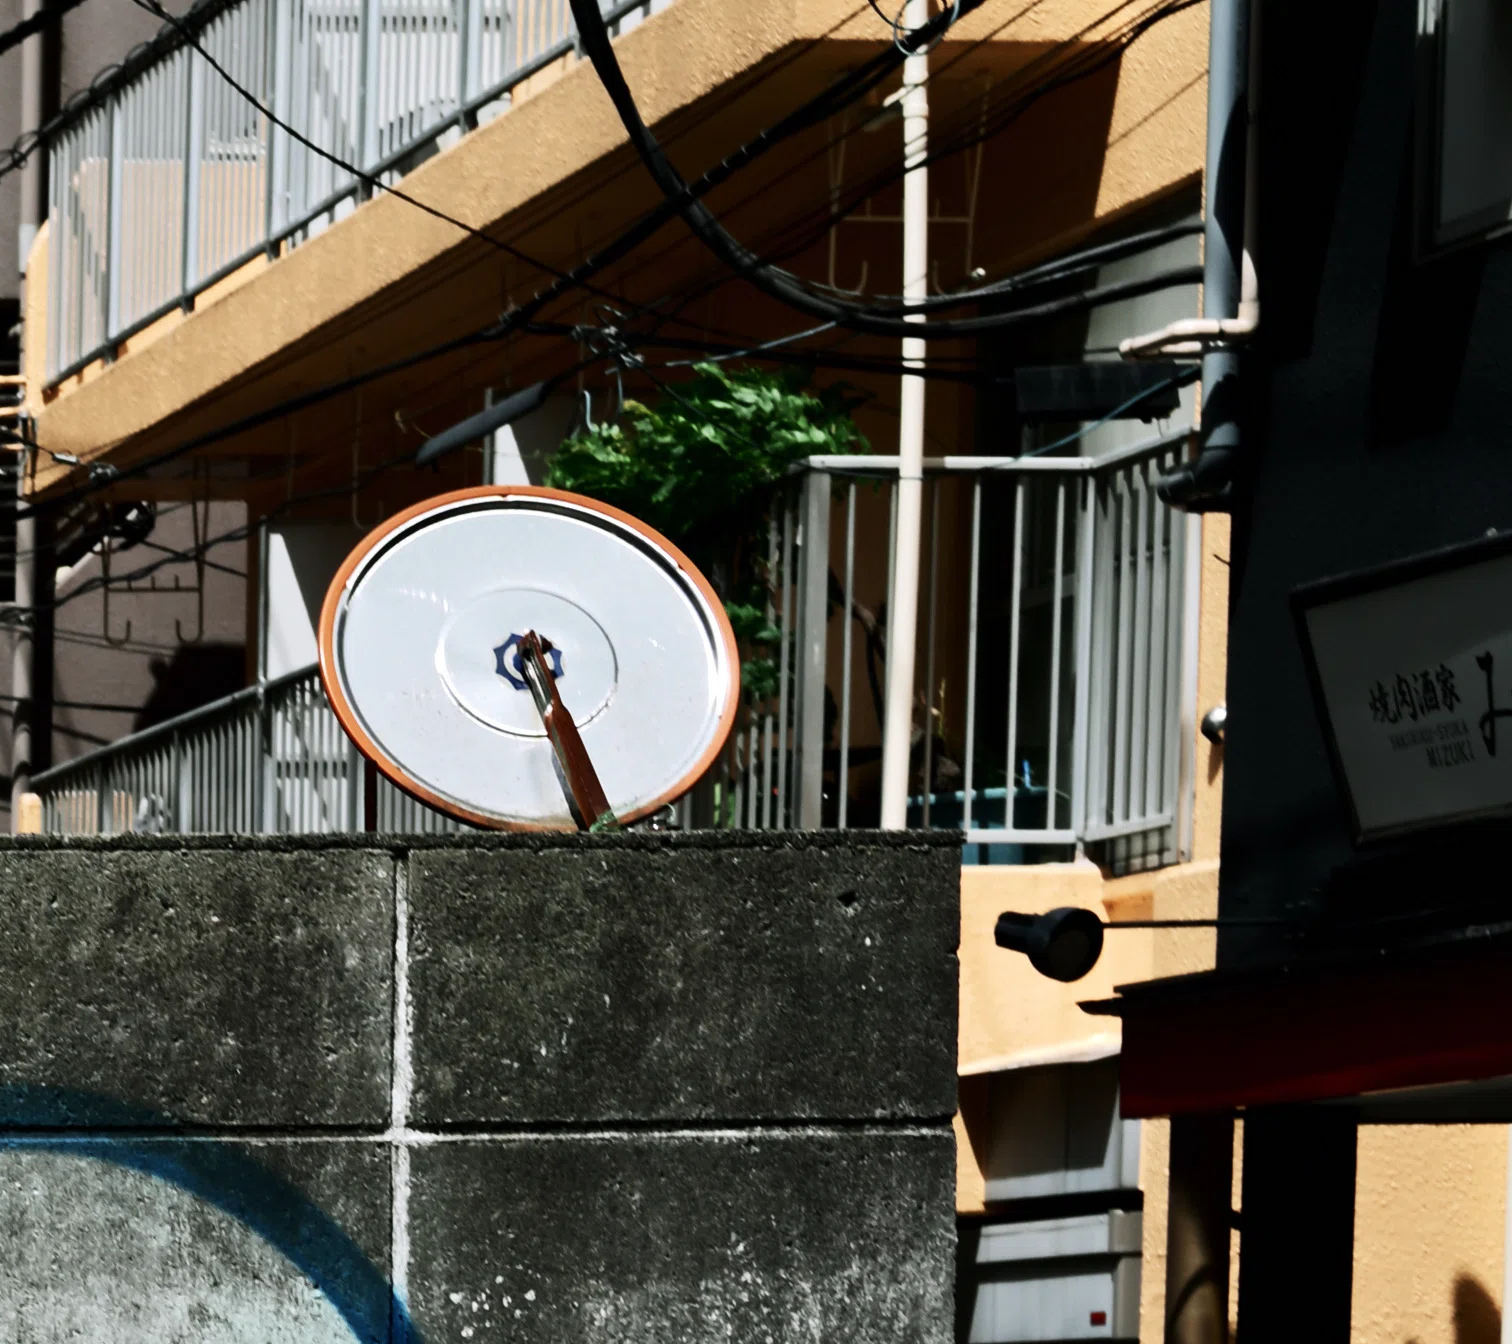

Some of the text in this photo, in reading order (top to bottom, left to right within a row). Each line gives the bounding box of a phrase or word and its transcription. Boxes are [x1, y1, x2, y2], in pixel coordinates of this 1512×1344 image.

[1368, 662, 1461, 724] 焼肉酒家
[1425, 740, 1475, 768] MIZUKI
